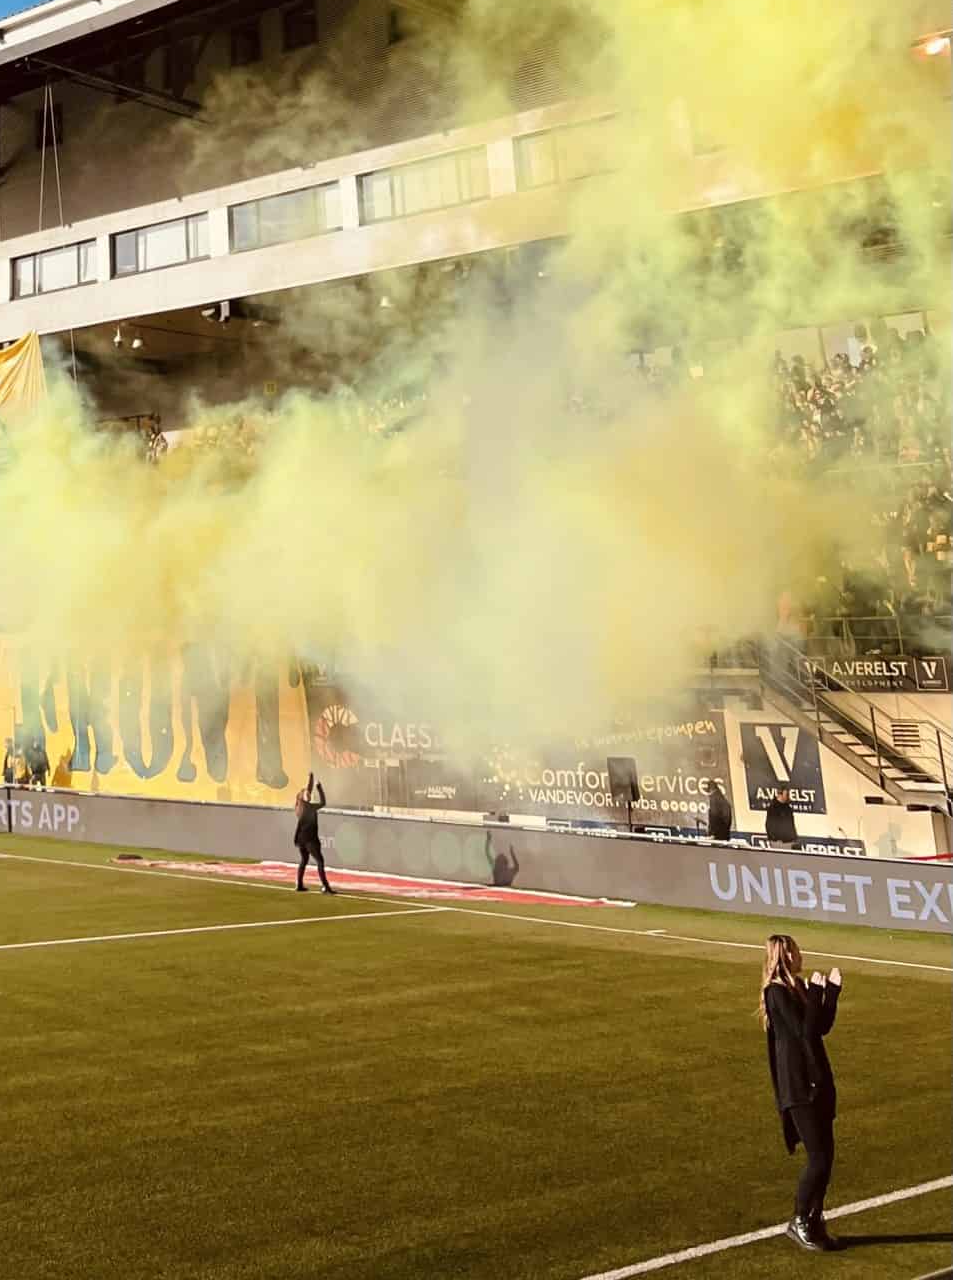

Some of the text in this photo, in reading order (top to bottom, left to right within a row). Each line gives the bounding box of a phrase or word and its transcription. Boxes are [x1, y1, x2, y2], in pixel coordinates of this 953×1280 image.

[832, 661, 908, 676] A.VERELST
[364, 722, 432, 749] CLAES
[755, 726, 800, 782] V
[525, 761, 726, 796] Comfor ervices
[529, 789, 621, 808] VANDEVOOR
[757, 787, 816, 802] A.VELST
[38, 803, 81, 833] APP
[709, 862, 953, 924] UNIBET EX
